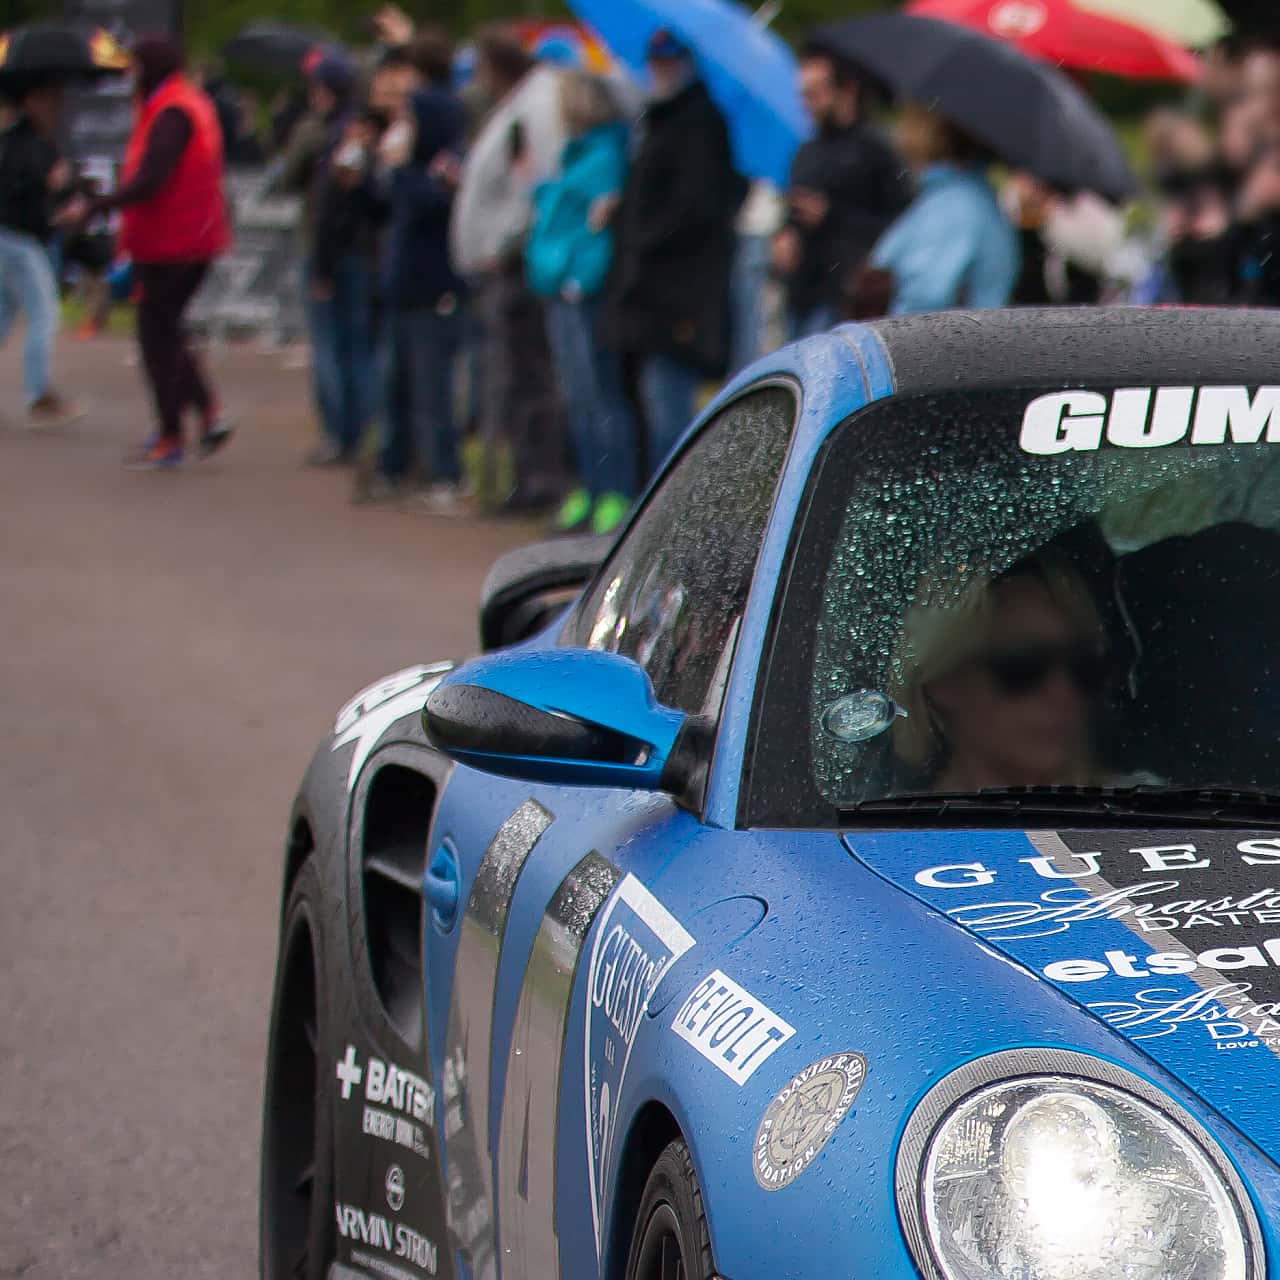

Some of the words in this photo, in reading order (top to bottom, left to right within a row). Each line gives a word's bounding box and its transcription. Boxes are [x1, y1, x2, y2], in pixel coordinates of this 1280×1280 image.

[676, 977, 786, 1071] REVOLT
[1216, 1039, 1259, 1050] Love
[779, 1059, 832, 1103] DAVID
[758, 1119, 815, 1182] FOUNDATION
